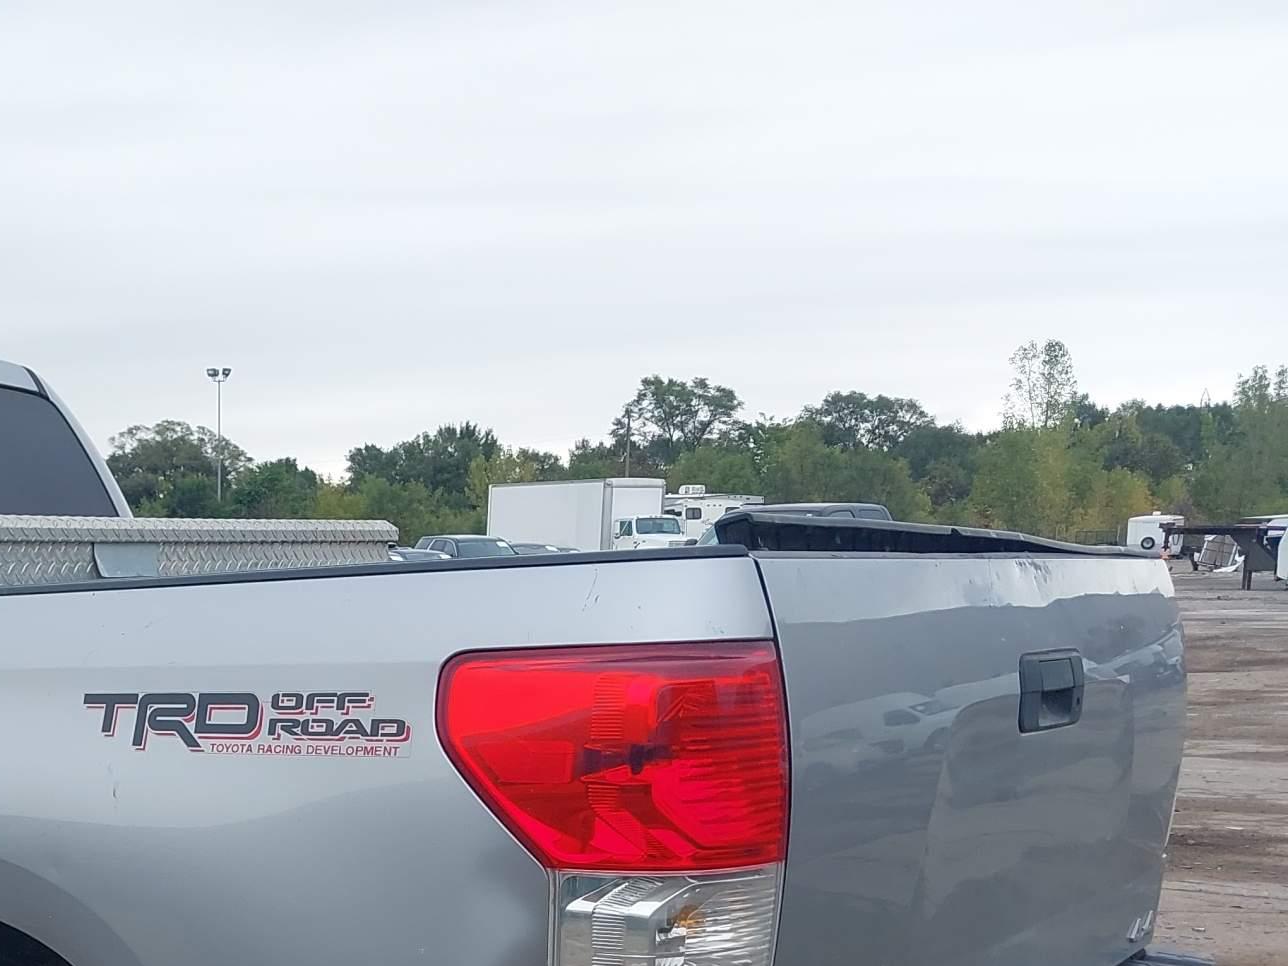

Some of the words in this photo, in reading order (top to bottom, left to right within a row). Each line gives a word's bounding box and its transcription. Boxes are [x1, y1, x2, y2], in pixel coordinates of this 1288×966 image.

[270, 692, 375, 715] OFF
[83, 692, 262, 752] TRD
[267, 718, 411, 742] ROAD
[209, 743, 253, 753] TOYOTA
[257, 744, 302, 755] RACING
[305, 744, 400, 757] DEVELOPMENT
